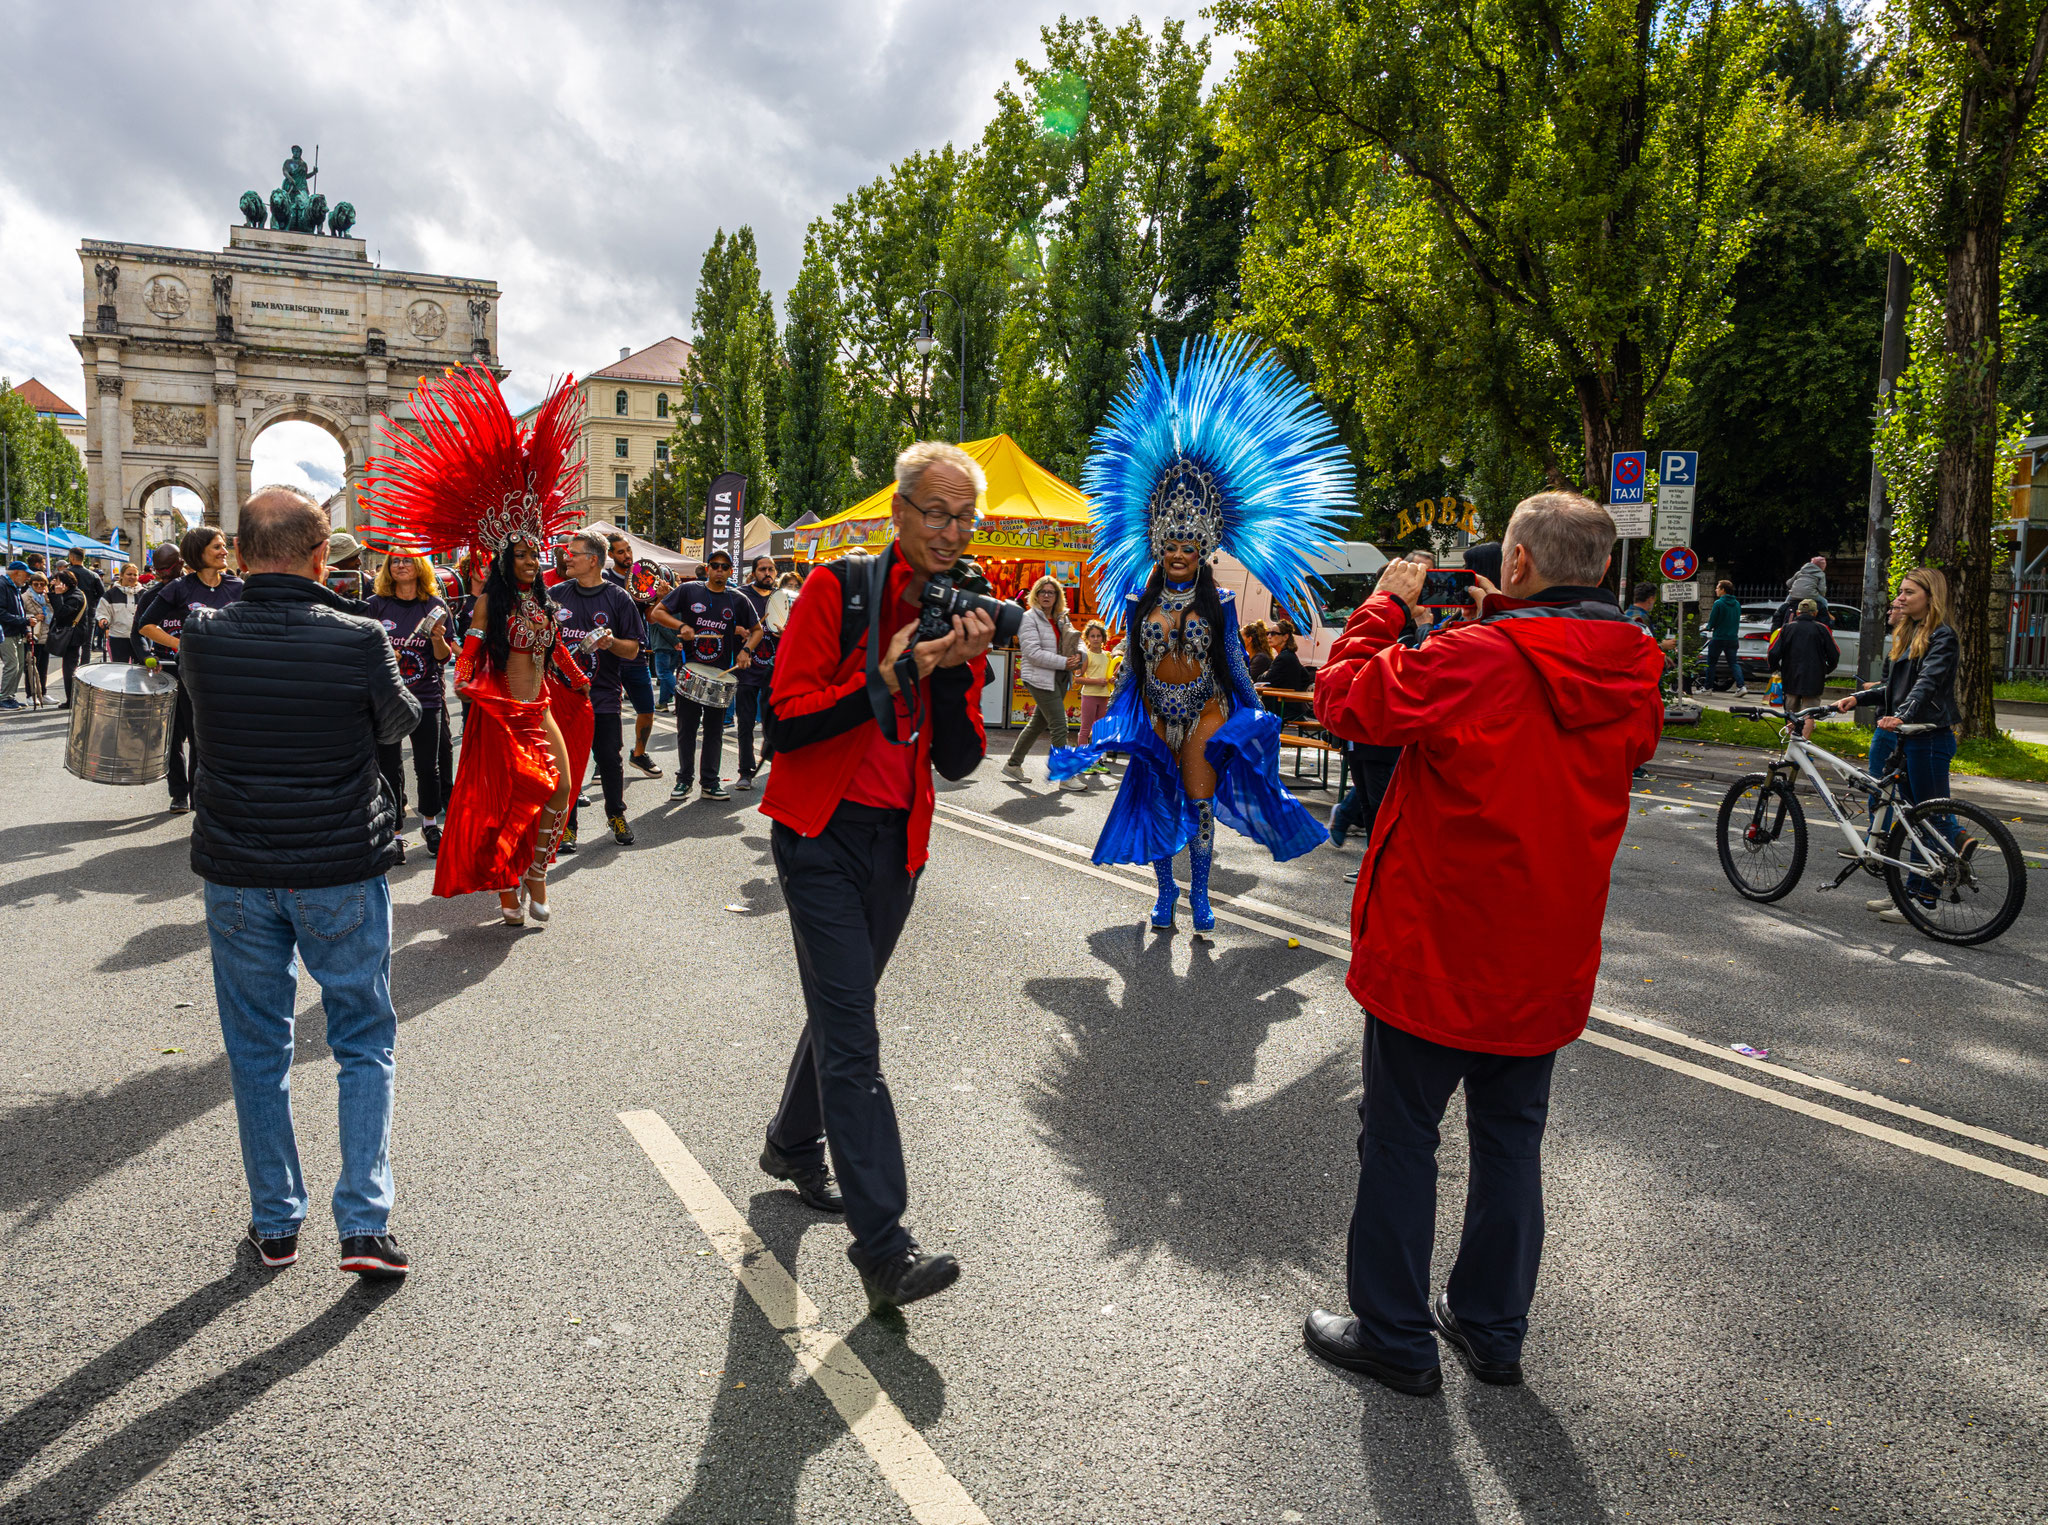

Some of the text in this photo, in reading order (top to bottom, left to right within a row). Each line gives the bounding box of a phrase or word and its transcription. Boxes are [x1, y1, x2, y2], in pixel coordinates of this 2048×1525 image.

[251, 301, 349, 316] DEM BAYERISCHEN HEERE
[1665, 455, 1686, 481] P
[1614, 488, 1640, 499] TAXI
[973, 531, 1057, 548] BOWLE
[163, 619, 181, 628] Bate
[696, 617, 727, 630] Bateria
